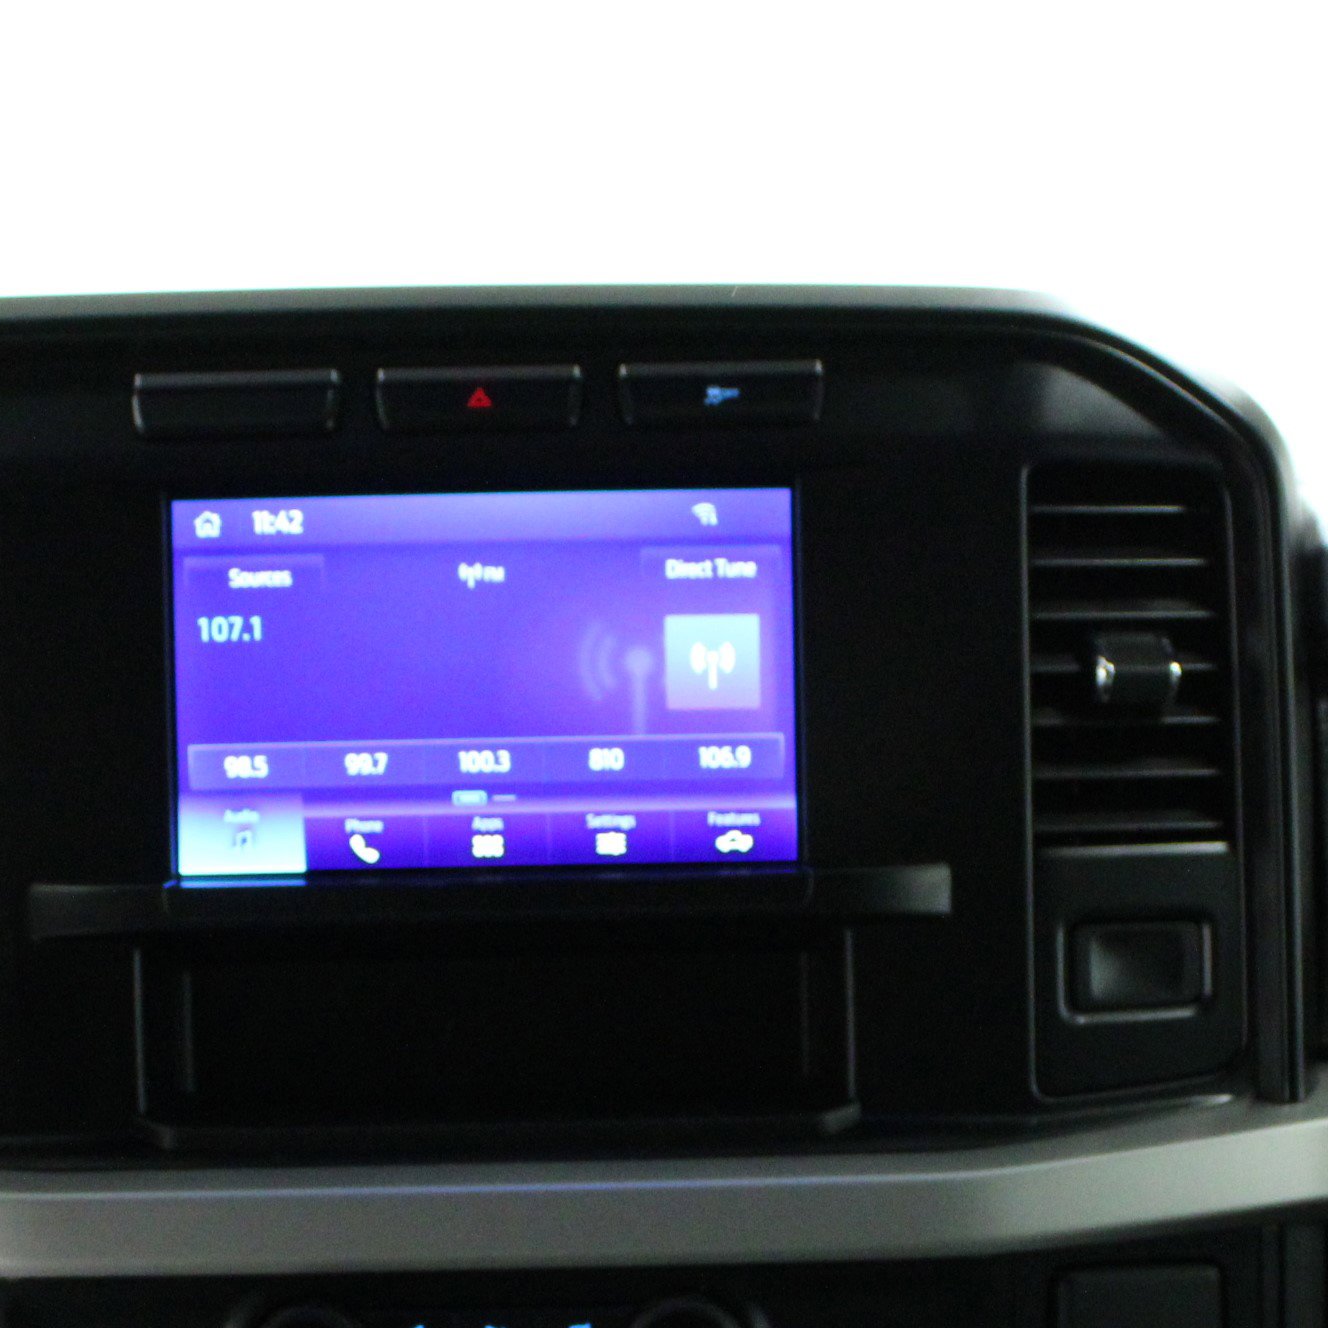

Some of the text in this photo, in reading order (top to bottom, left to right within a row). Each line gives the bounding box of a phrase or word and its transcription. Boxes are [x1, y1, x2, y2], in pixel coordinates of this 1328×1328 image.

[252, 509, 304, 535] 11:42
[228, 567, 293, 588] Sources
[665, 558, 757, 579] Direct Tune
[197, 615, 262, 643] 107.1
[345, 752, 388, 776] 99.7
[458, 750, 510, 773] 100.3
[698, 745, 752, 770] 106.9
